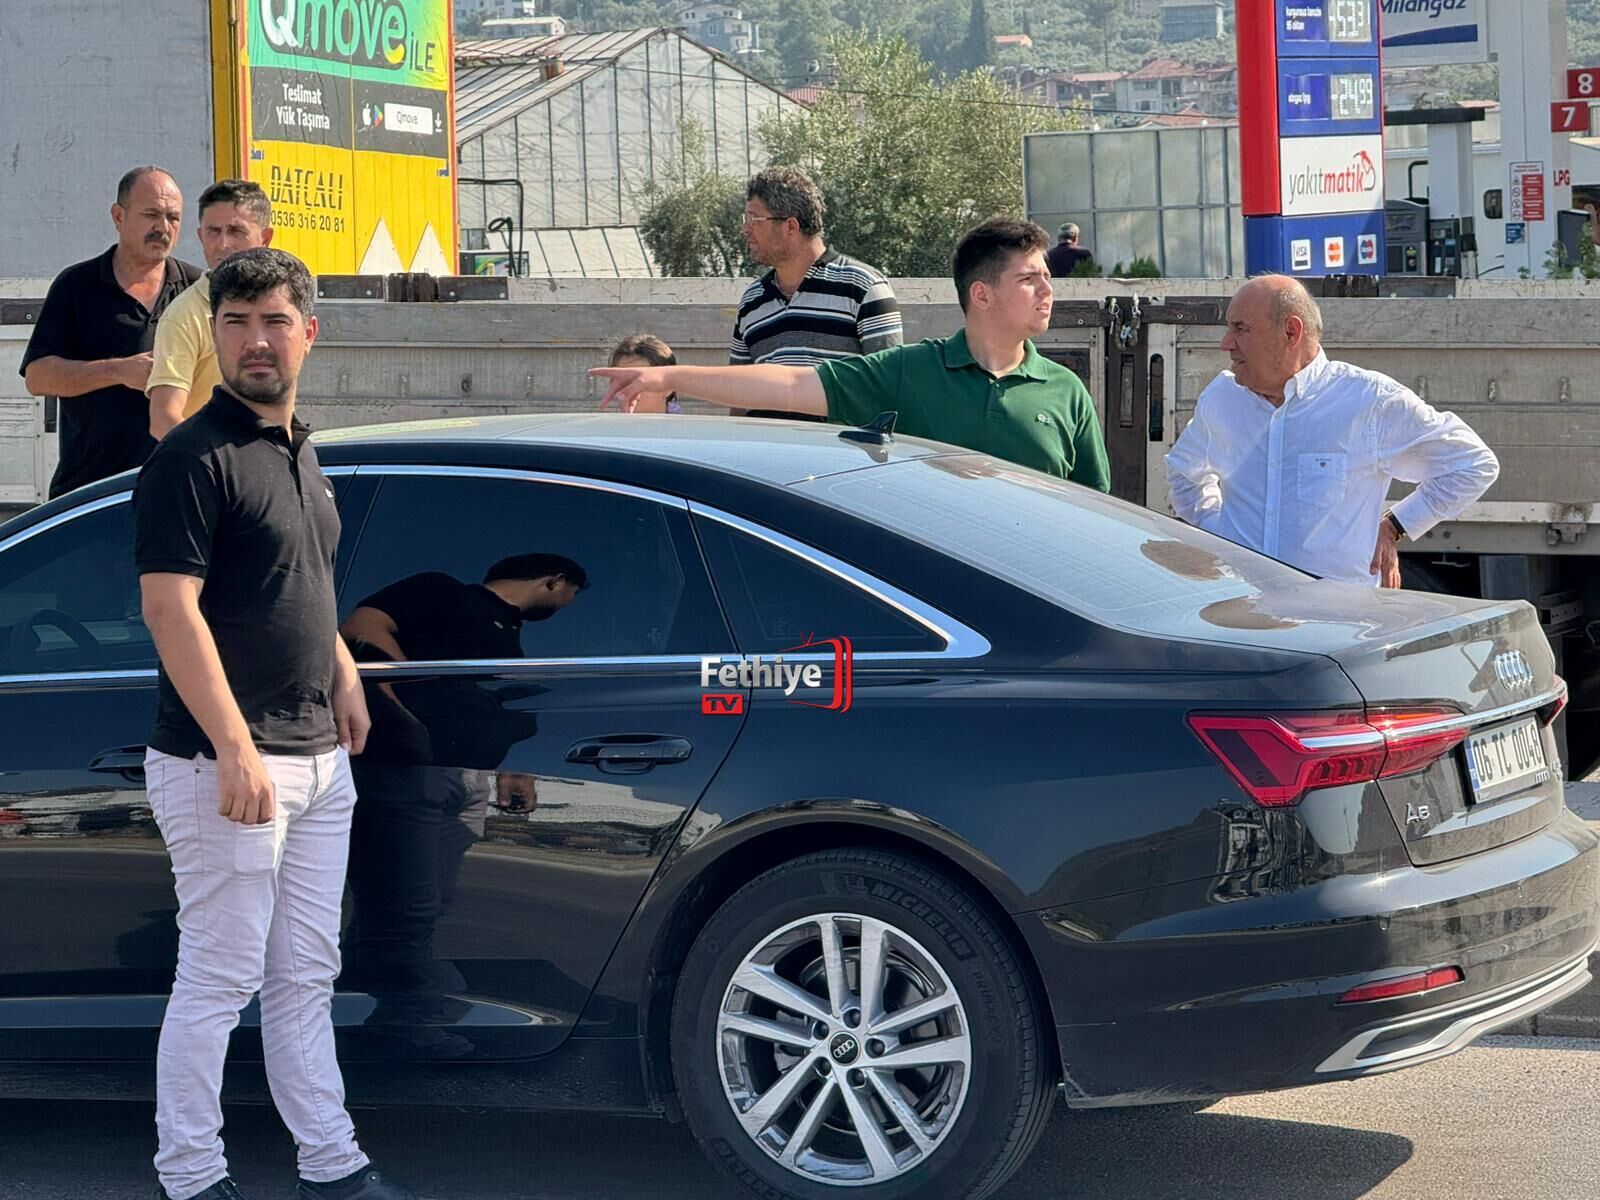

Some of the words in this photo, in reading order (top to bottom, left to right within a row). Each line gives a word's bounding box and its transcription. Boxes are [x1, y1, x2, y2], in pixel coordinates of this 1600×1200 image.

[261, 0, 406, 65] Qmove
[282, 84, 322, 105] Teslimat
[1577, 72, 1593, 94] 8
[275, 106, 295, 126] Yük
[296, 108, 331, 131] Taşıma
[1561, 106, 1576, 128] 7
[270, 165, 343, 211] DATÇALI
[1553, 169, 1571, 187] LPG
[270, 209, 295, 229] 0536
[298, 213, 317, 231] 316
[319, 215, 331, 232] 20
[334, 217, 345, 234] 81
[1472, 738, 1493, 782] 06
[1492, 731, 1512, 777] TC
[1511, 723, 1542, 771] 0048
[1405, 802, 1431, 825] A6
[871, 881, 971, 957] MICHELIN
